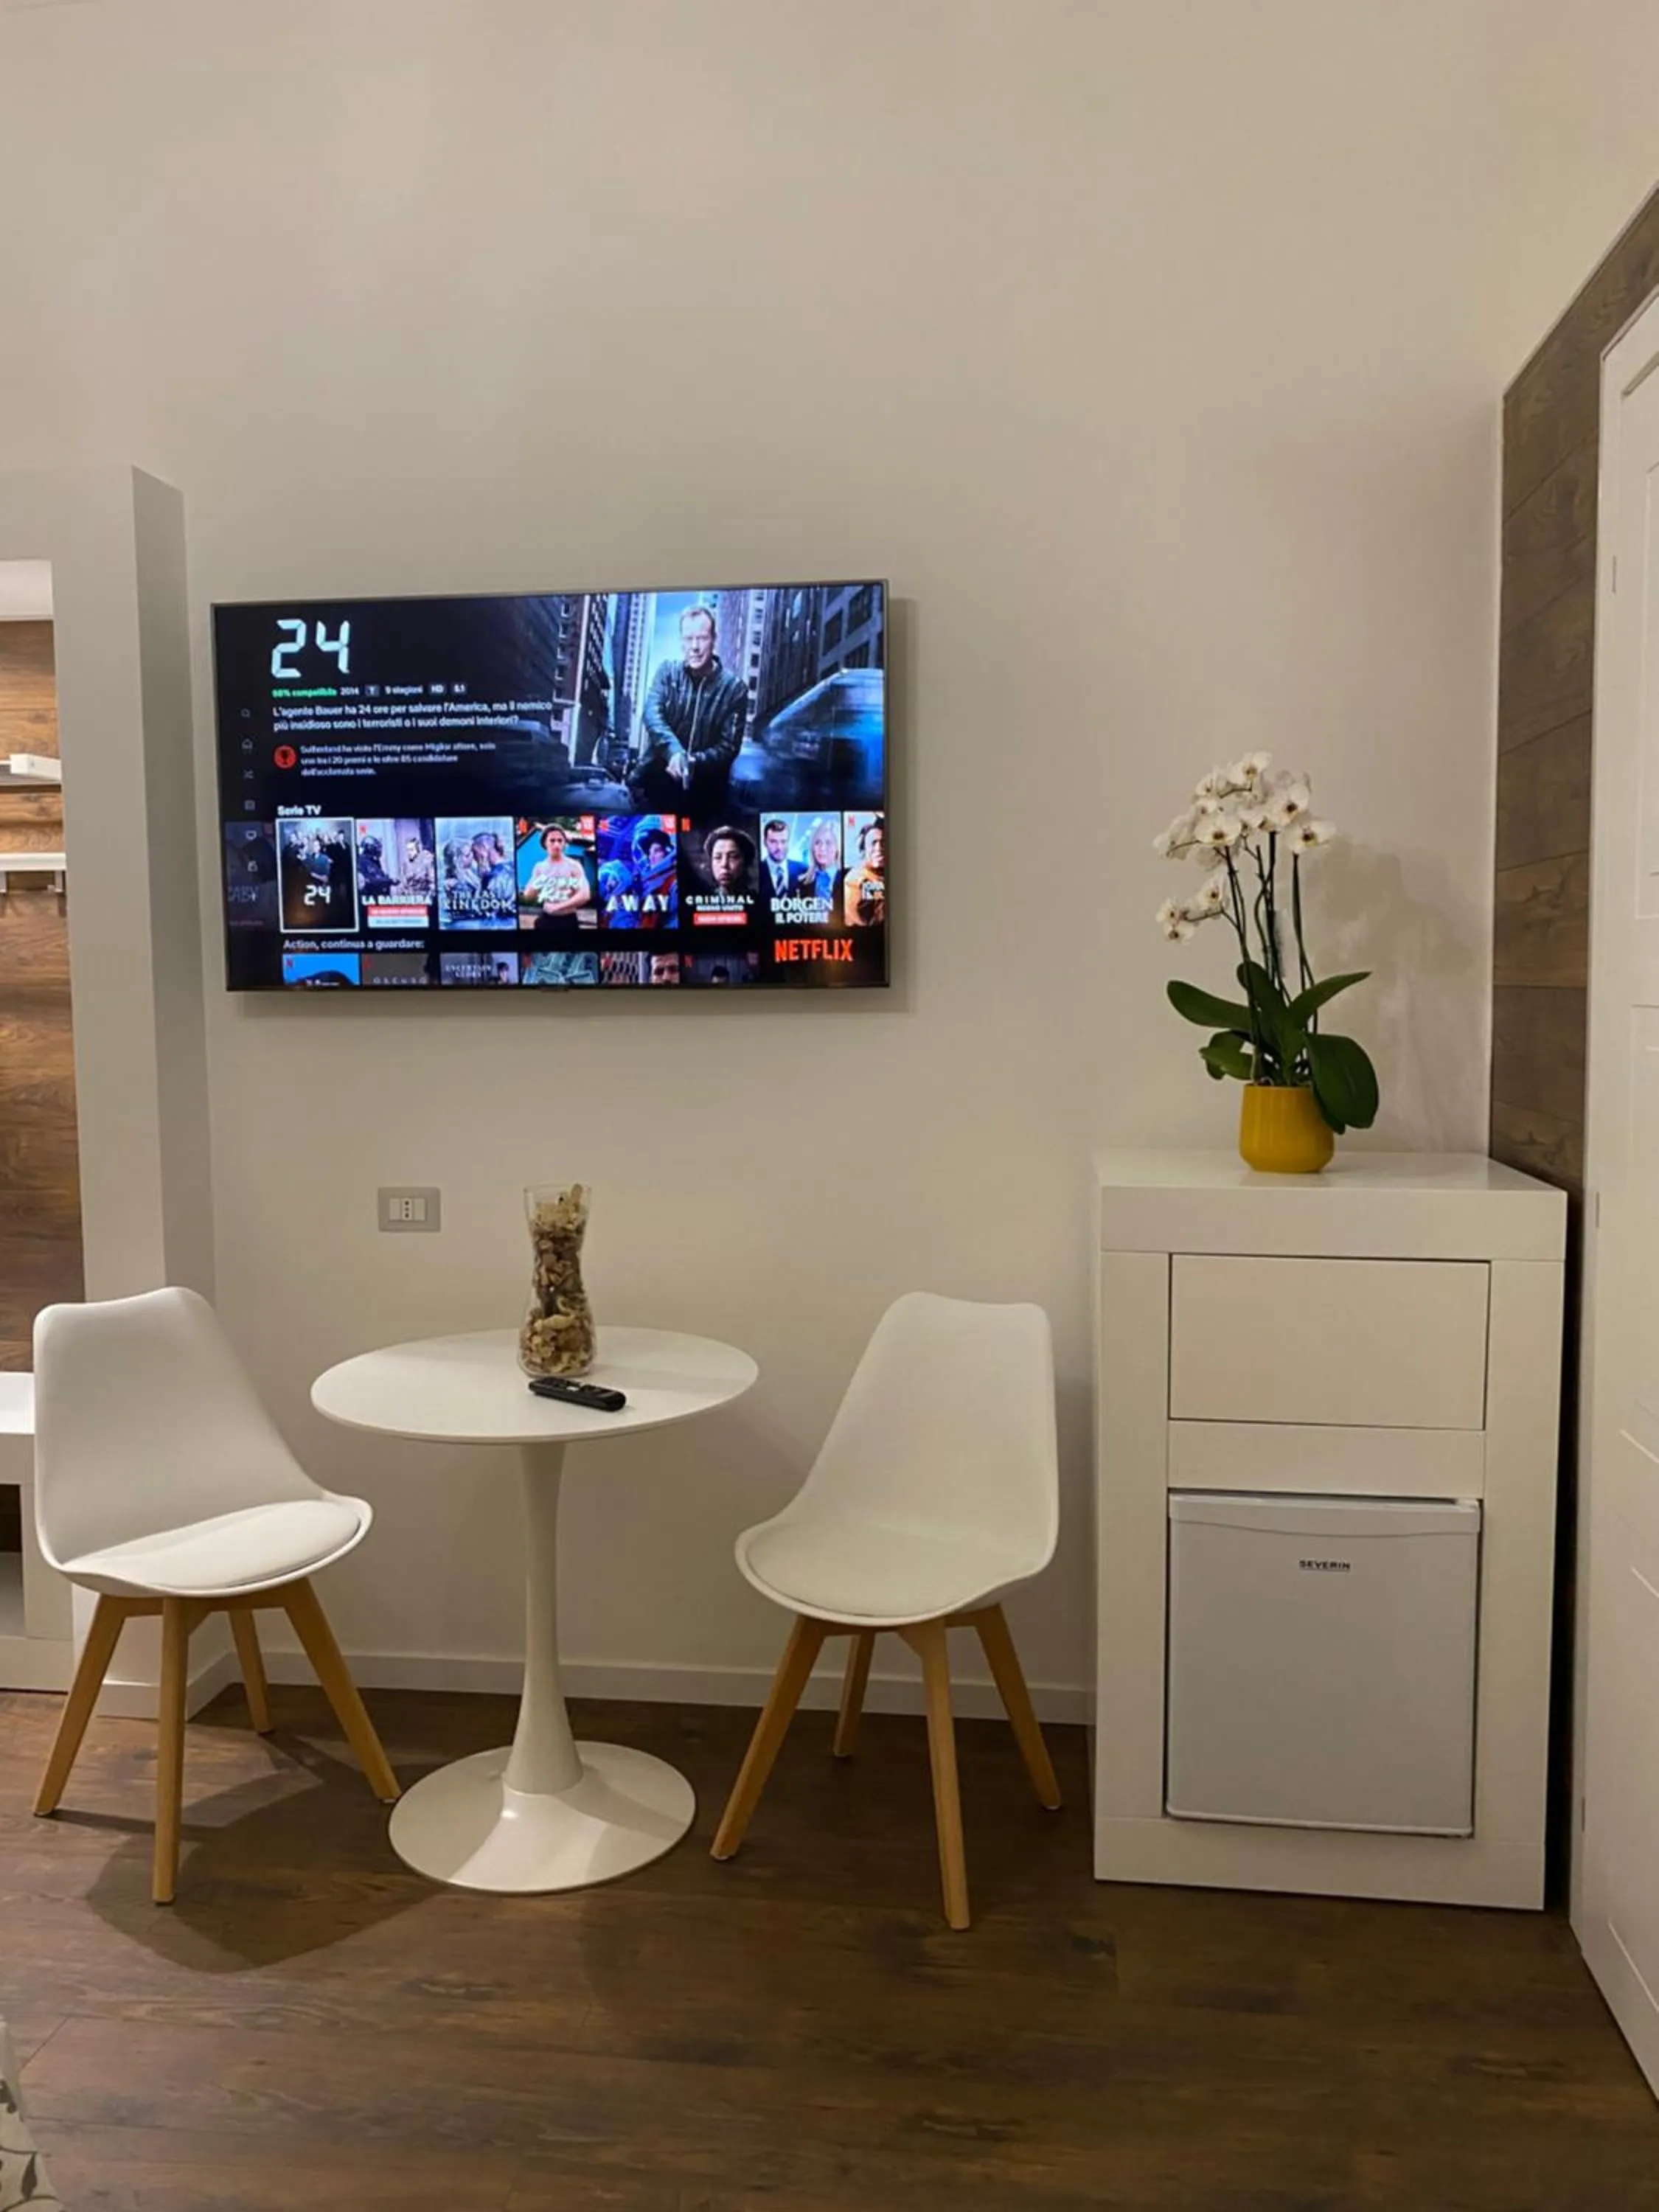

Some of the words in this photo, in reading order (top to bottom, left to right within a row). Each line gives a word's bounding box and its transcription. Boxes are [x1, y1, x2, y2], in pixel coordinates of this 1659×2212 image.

[270, 618, 351, 678] 24
[272, 706, 314, 718] L'agente
[315, 705, 343, 715] Bauer
[344, 704, 357, 714] ha
[358, 703, 371, 714] 24
[372, 705, 389, 714] ore
[390, 705, 406, 715] per
[408, 703, 442, 713] salvare
[492, 703, 507, 711] ma
[516, 701, 552, 710] nemico
[290, 720, 331, 730] insidioso
[333, 720, 356, 728] sono
[362, 717, 403, 728] terroristi
[439, 715, 475, 726] demoni
[277, 804, 304, 816] Serie
[305, 804, 321, 815] TV
[303, 885, 331, 905] 24
[361, 894, 376, 905] LA
[606, 894, 669, 911] AWAY
[685, 894, 755, 905] CRIMINAL
[770, 896, 833, 912] BORGEN
[775, 912, 785, 924] IL
[786, 911, 830, 924] POTERE
[283, 939, 319, 950] Action,
[321, 939, 365, 949] continua
[366, 940, 375, 949] a
[775, 938, 854, 962] NETFLIX
[1298, 1559, 1351, 1569] SEVERIN
